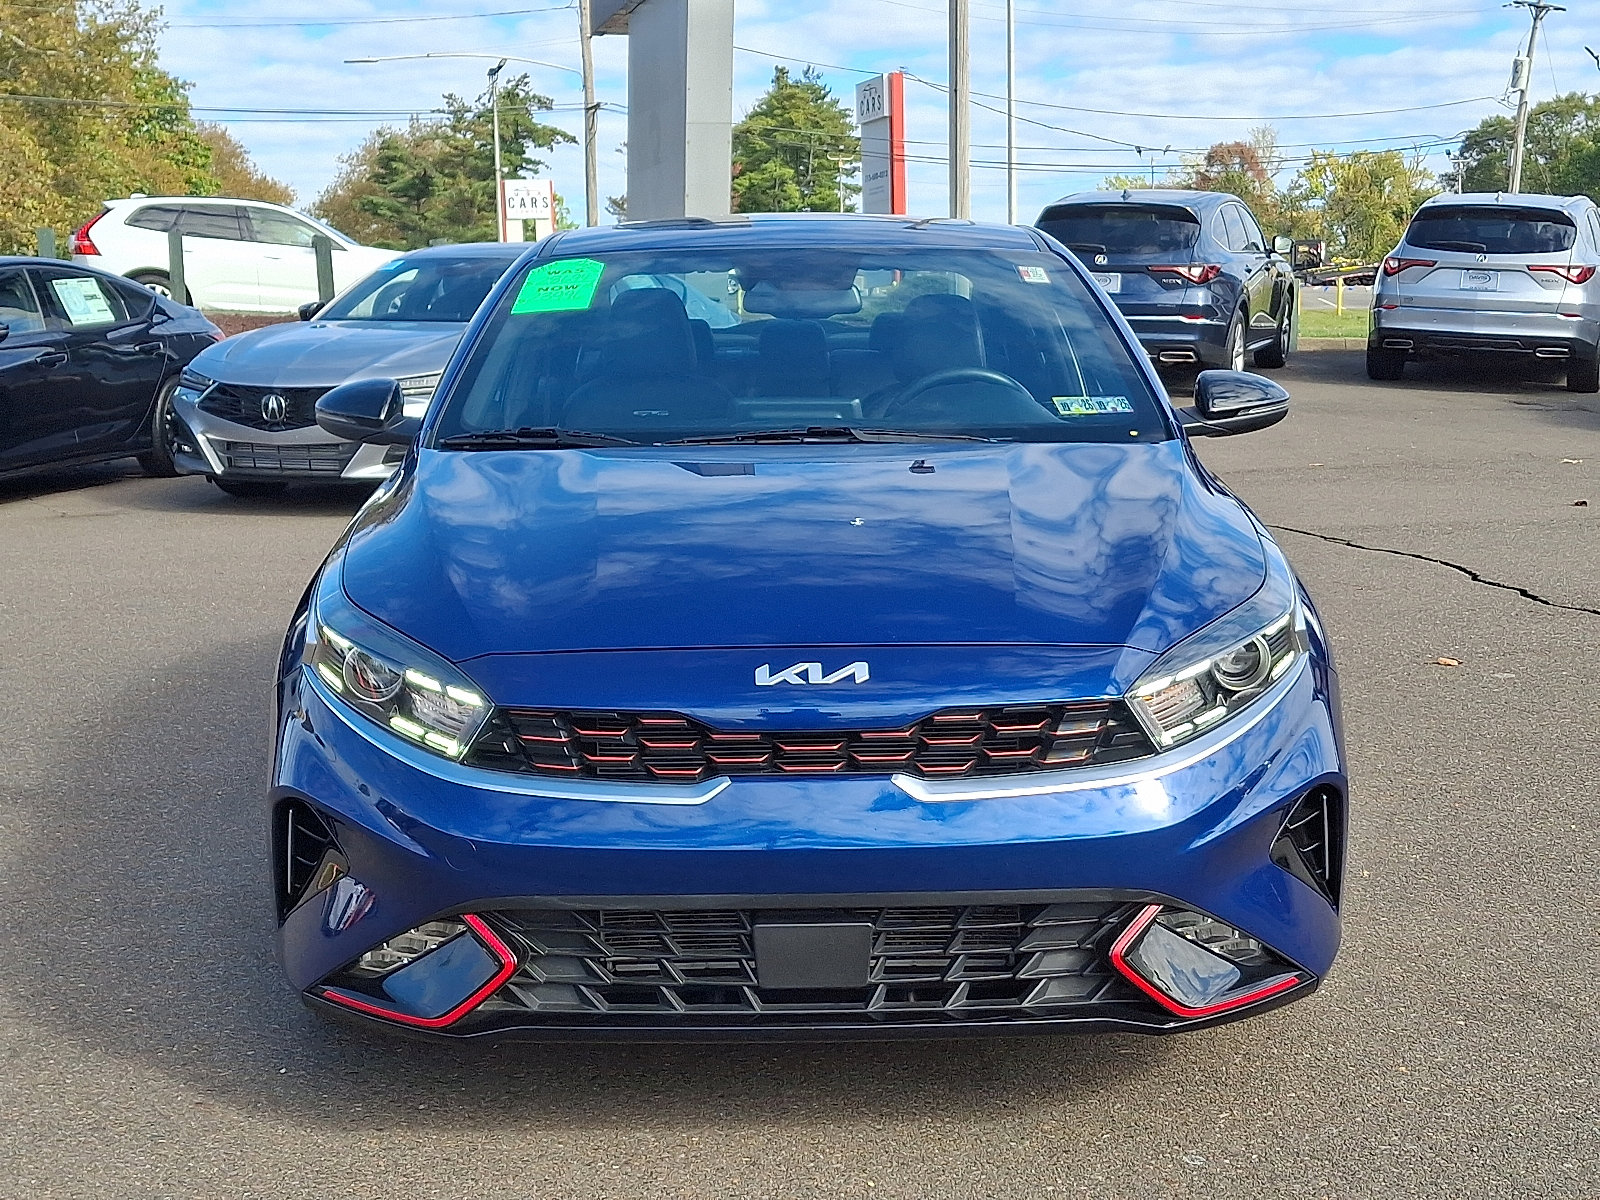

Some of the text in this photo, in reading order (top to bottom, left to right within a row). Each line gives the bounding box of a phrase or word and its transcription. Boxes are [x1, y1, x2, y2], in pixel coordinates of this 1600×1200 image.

[860, 94, 882, 117] CARS
[508, 196, 549, 209] CARS
[547, 268, 585, 276] WAS
[537, 284, 580, 293] NOW
[754, 661, 871, 686] KIA
